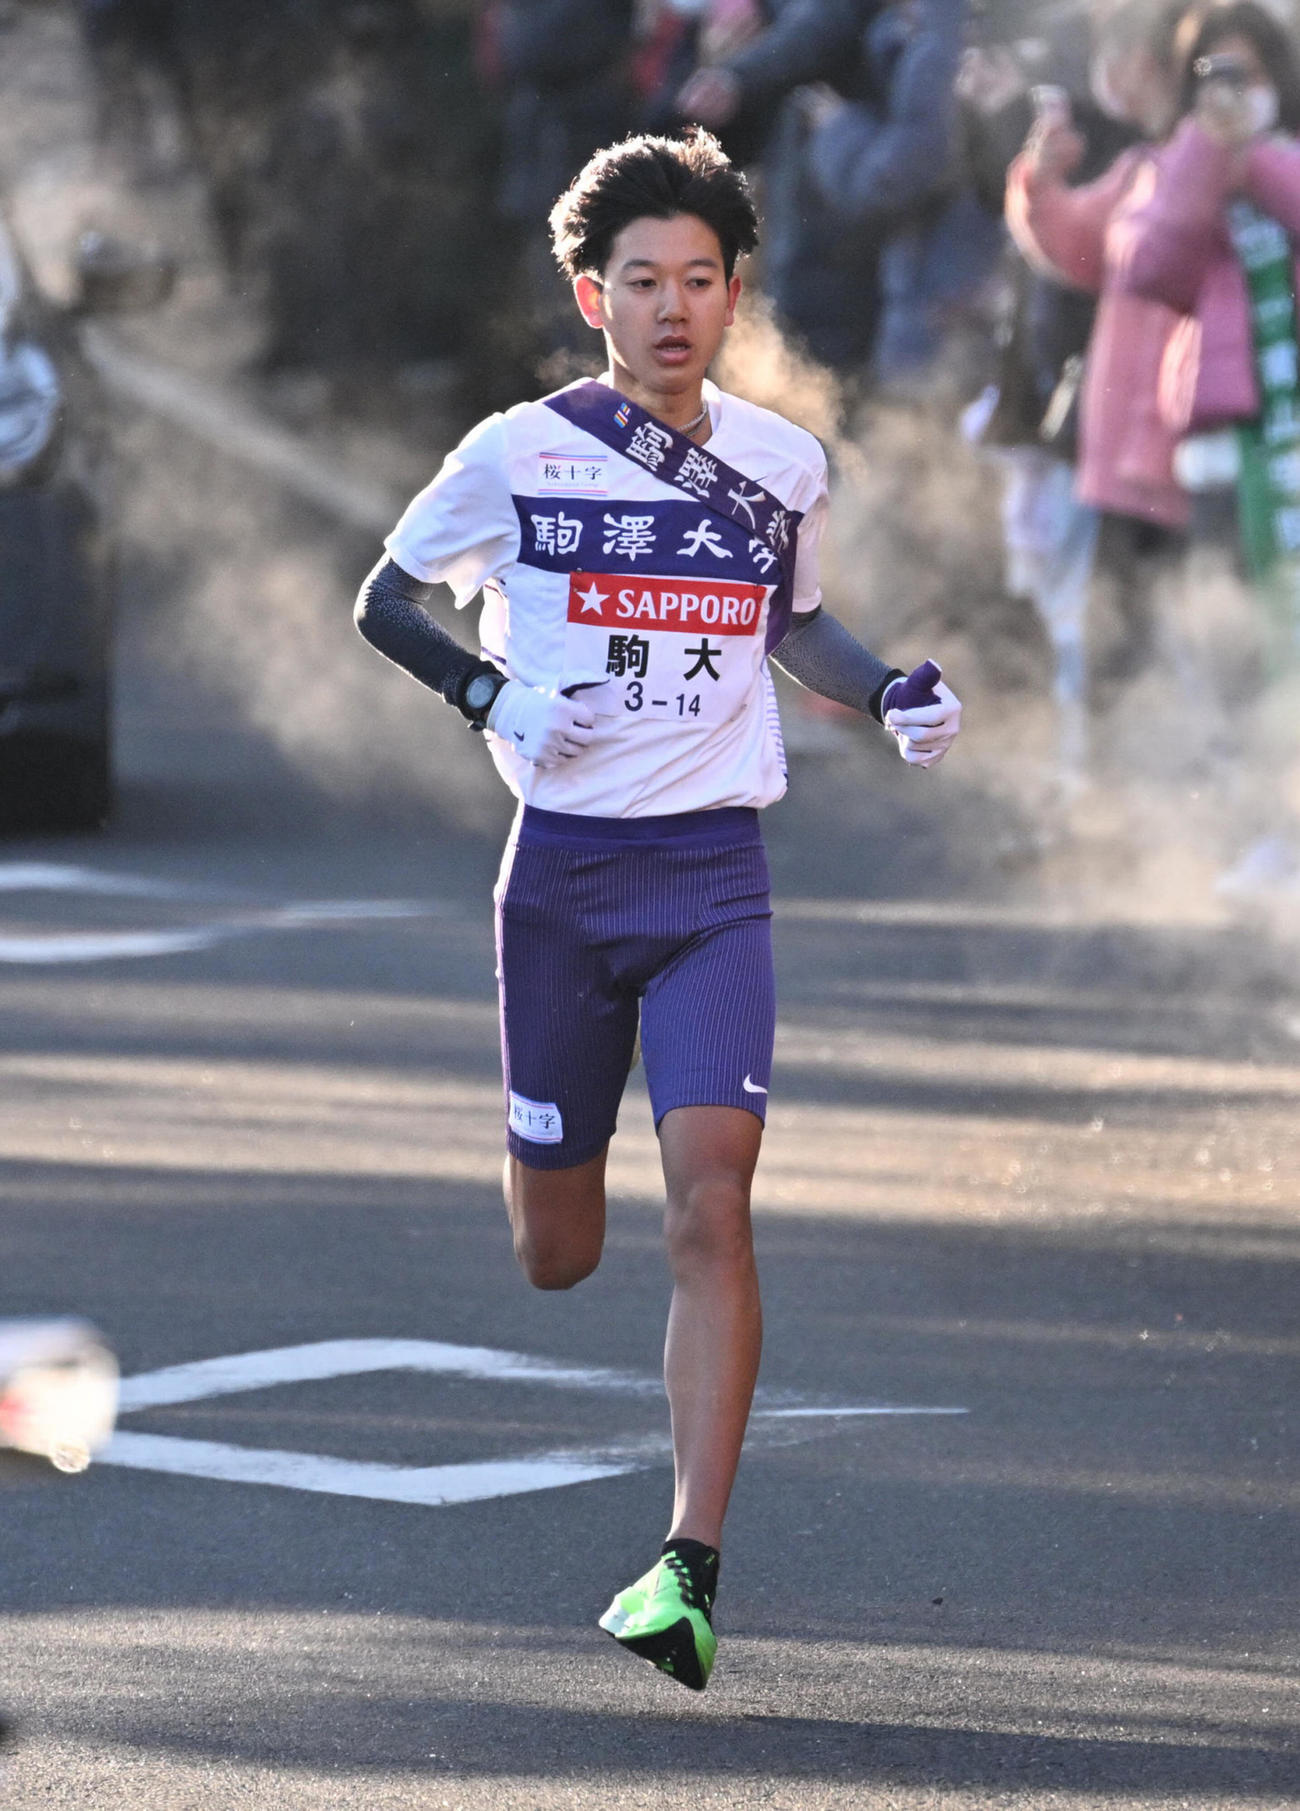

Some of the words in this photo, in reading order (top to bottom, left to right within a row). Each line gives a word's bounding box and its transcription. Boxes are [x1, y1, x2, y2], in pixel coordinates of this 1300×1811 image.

[543, 463, 602, 480] 桜十字
[625, 421, 792, 555] 駒澤大学
[616, 588, 757, 626] SAPPORO
[605, 634, 722, 682] 駒大
[624, 681, 701, 717] 3-14
[513, 1103, 556, 1130] 桜十字
